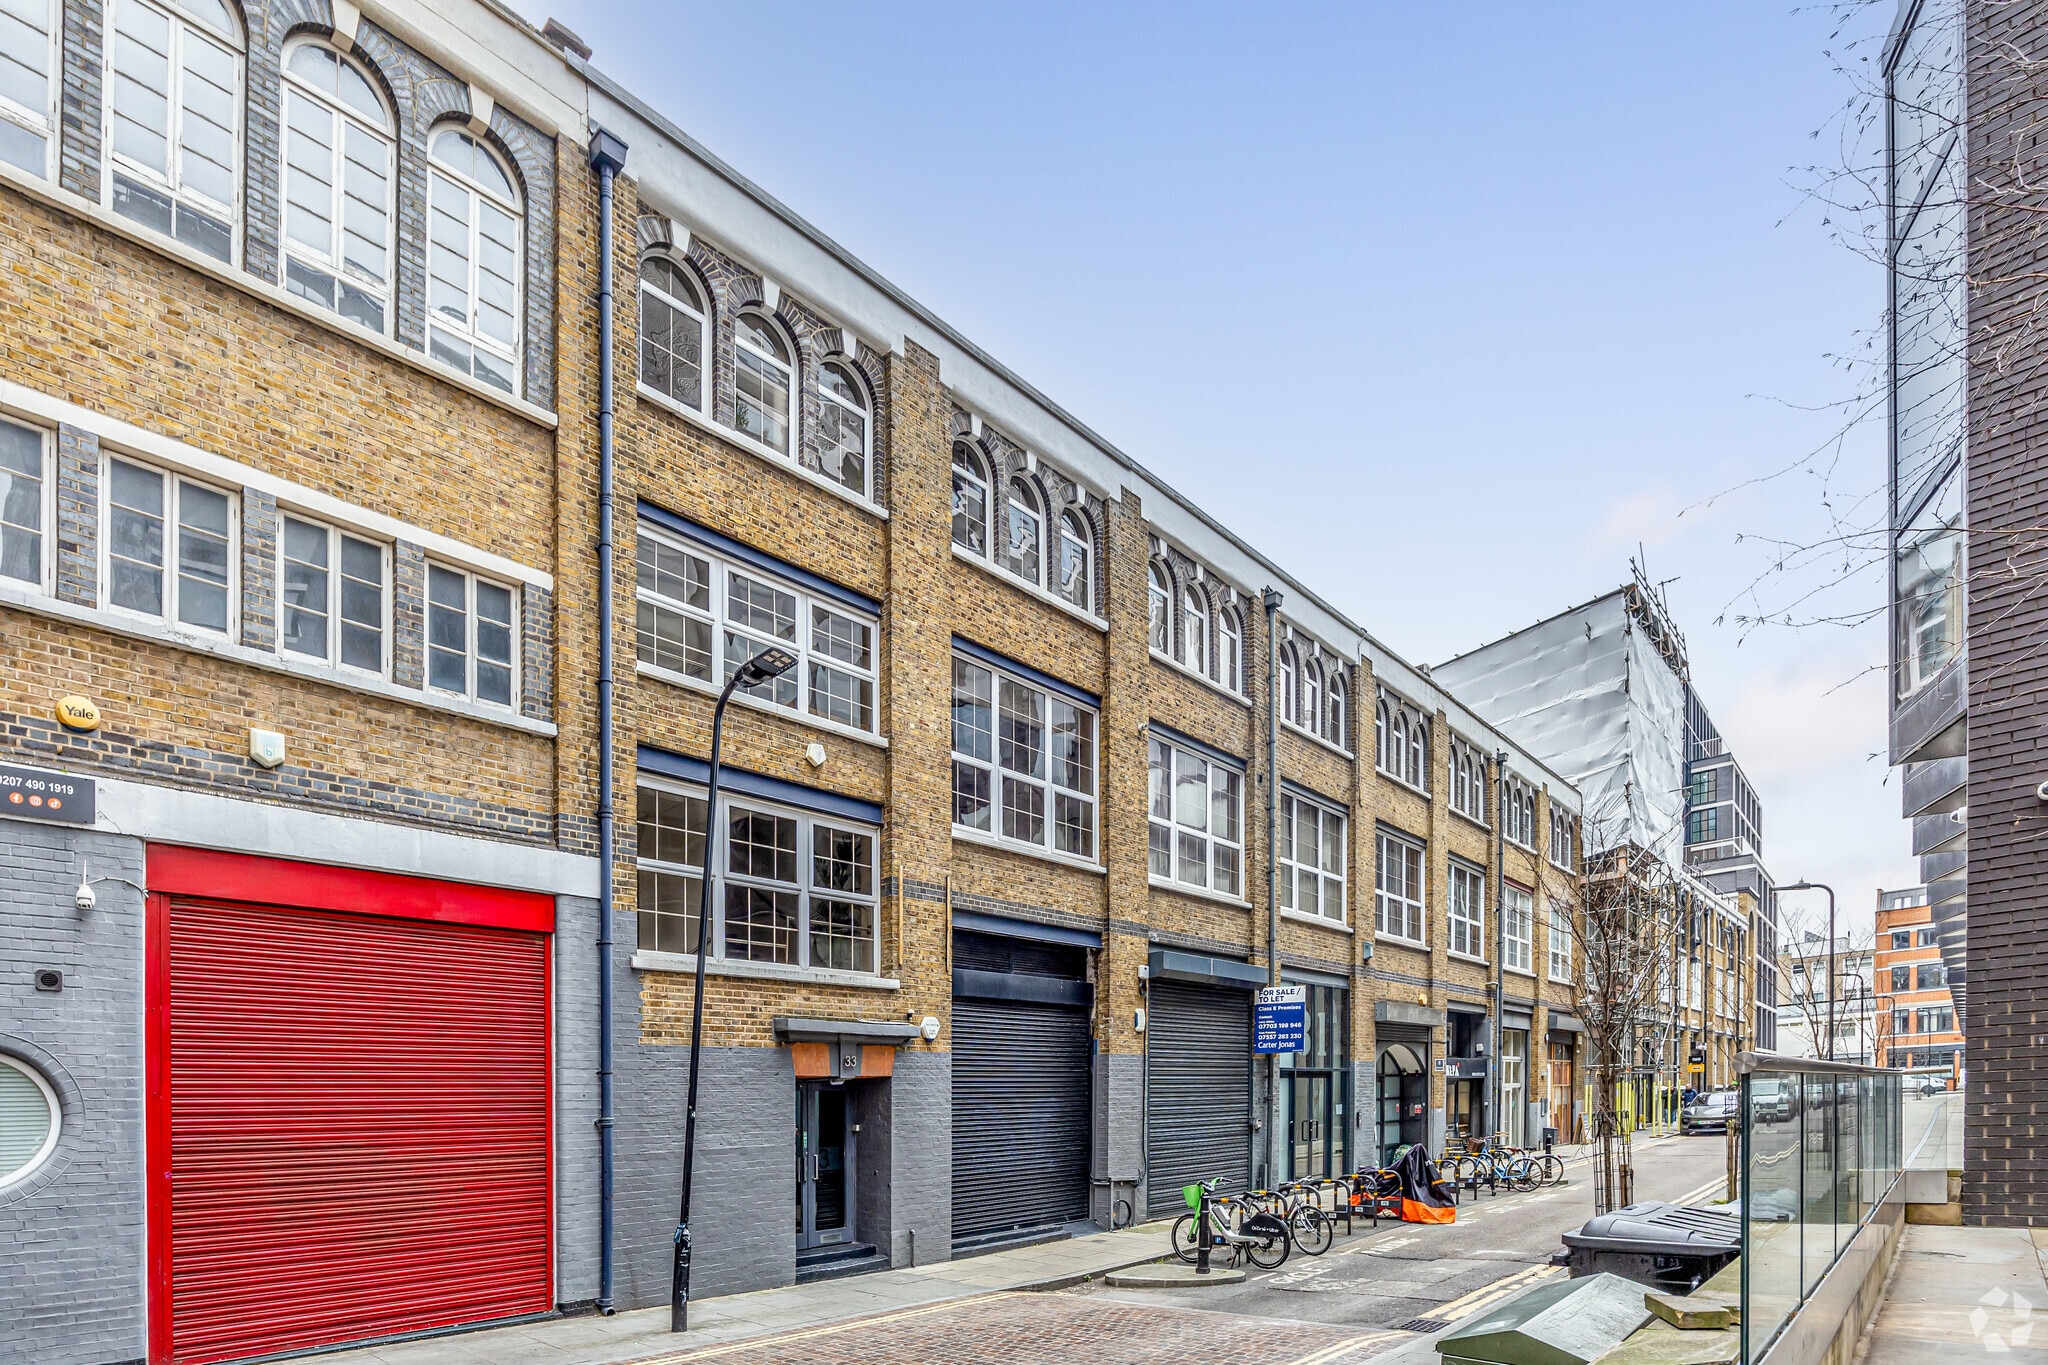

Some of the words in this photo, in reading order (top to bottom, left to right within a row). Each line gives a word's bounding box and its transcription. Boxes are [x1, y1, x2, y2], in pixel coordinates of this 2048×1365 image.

[64, 705, 94, 720] Yale
[25, 779, 45, 791] 490
[48, 782, 74, 795] 1919
[1277, 988, 1295, 996] SALE
[1257, 1041, 1278, 1049] Carter
[1277, 1040, 1296, 1049] Jonas
[844, 1055, 857, 1068] 33
